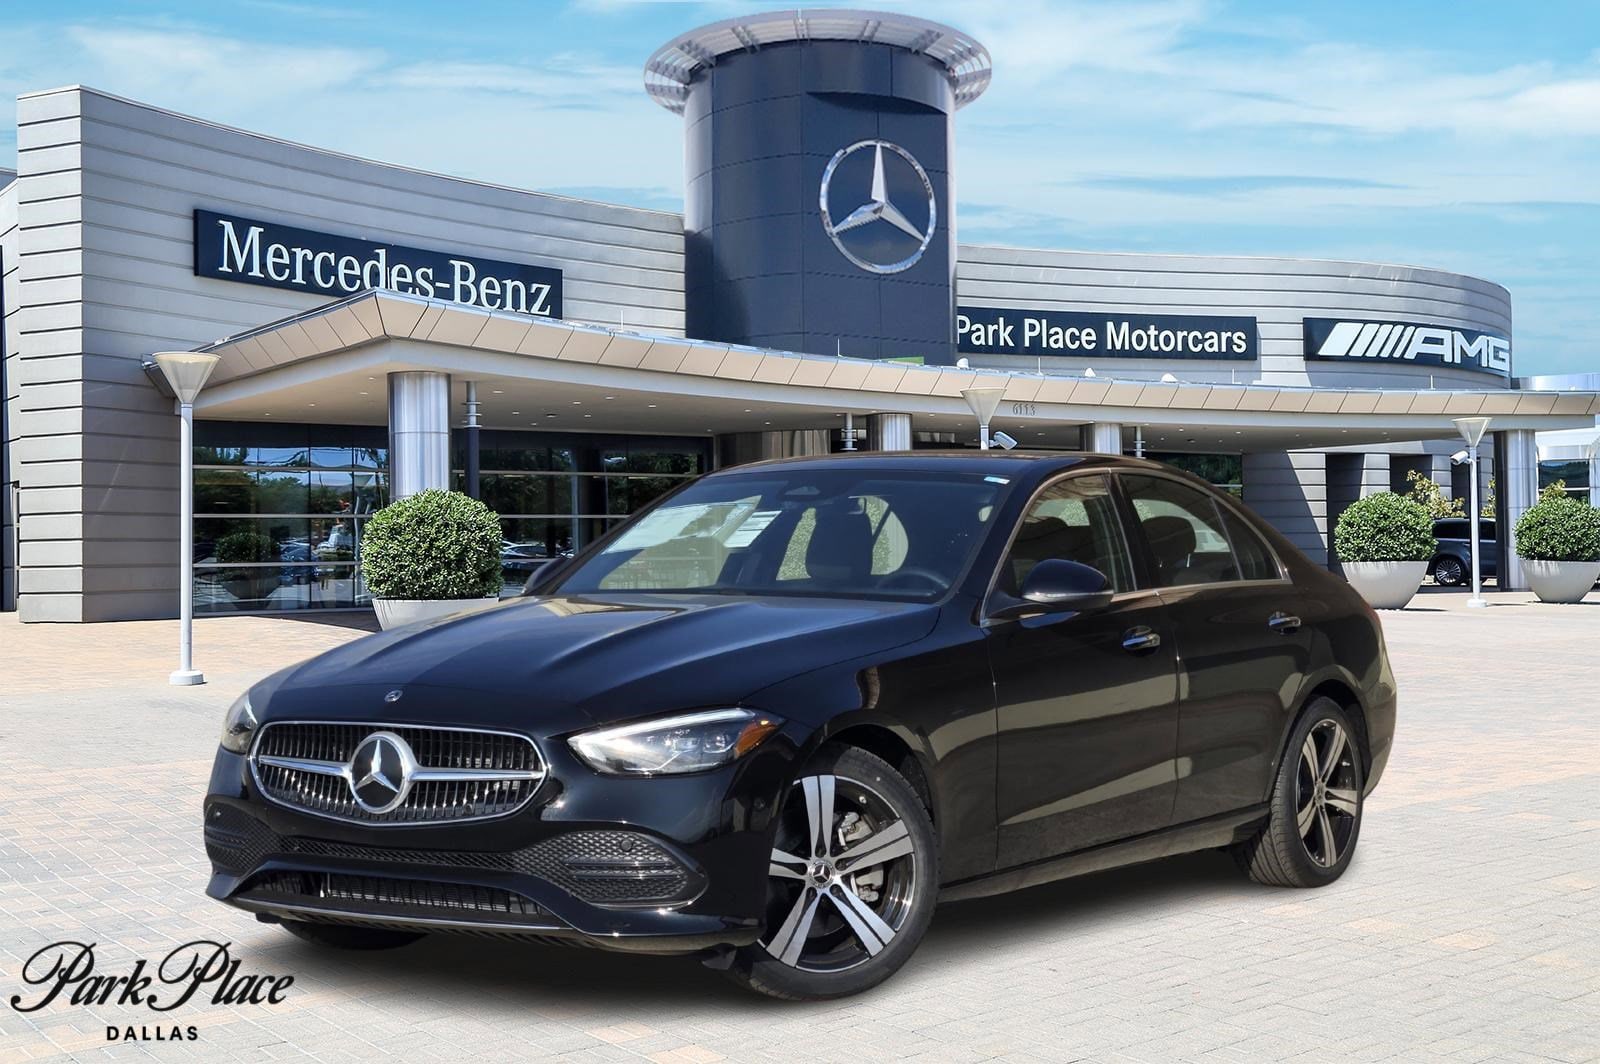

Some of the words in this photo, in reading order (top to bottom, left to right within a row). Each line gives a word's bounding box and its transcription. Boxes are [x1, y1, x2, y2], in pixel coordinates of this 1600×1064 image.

[217, 219, 552, 316] Mercedes-Benz
[957, 315, 1015, 347] Park
[1023, 317, 1097, 350] Place
[1106, 321, 1248, 354] Motorcars
